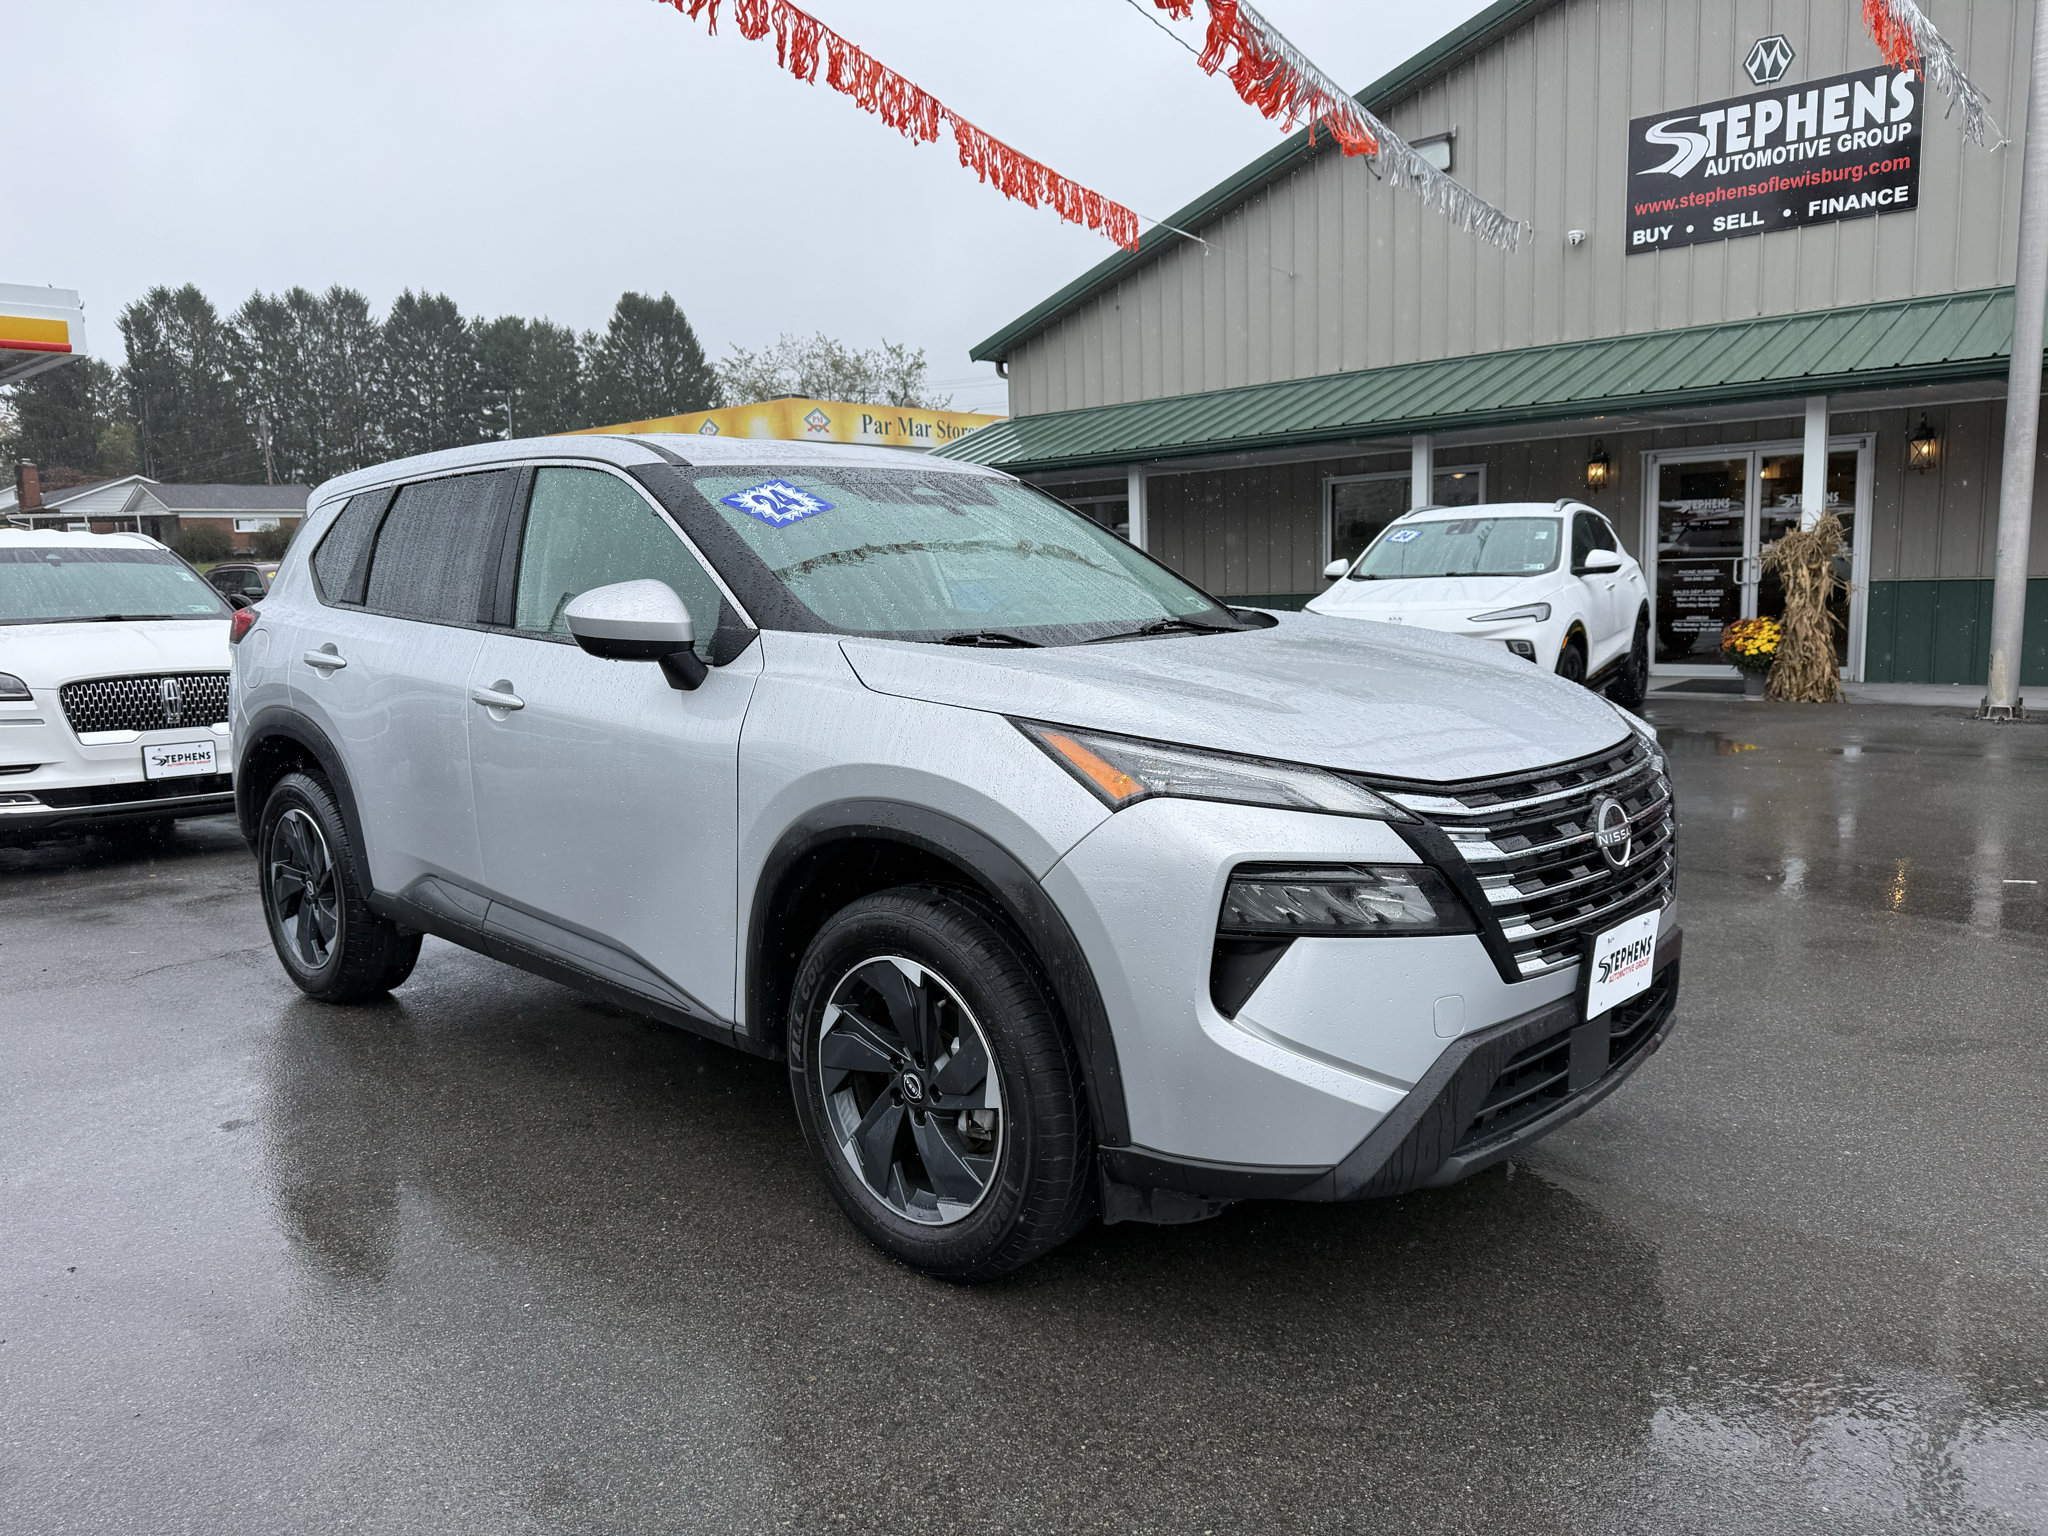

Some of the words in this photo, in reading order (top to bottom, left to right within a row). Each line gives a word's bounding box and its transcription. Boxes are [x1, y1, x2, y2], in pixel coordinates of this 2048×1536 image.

[1636, 69, 1915, 178] STEPHENS
[1704, 140, 1831, 178] AUTOMOTIVE
[1837, 122, 1912, 151] GROUP
[1634, 155, 1911, 216] www.stephensoflewisburg.com
[1632, 225, 1673, 245] BUY
[1712, 210, 1765, 233] SELL
[1808, 186, 1909, 217] FINANCE
[861, 413, 892, 435] Par
[897, 416, 932, 438] Mar
[936, 419, 979, 439] Store
[751, 488, 805, 516] 24
[1673, 498, 1731, 513] STEPHENS
[1778, 491, 1839, 508] STENS
[152, 751, 211, 767] STEPHENS
[1598, 824, 1632, 846] NISSA
[1596, 934, 1653, 984] STEPHENS
[1608, 964, 1635, 984] AUTOMOTIVE
[1635, 956, 1650, 971] GROUP
